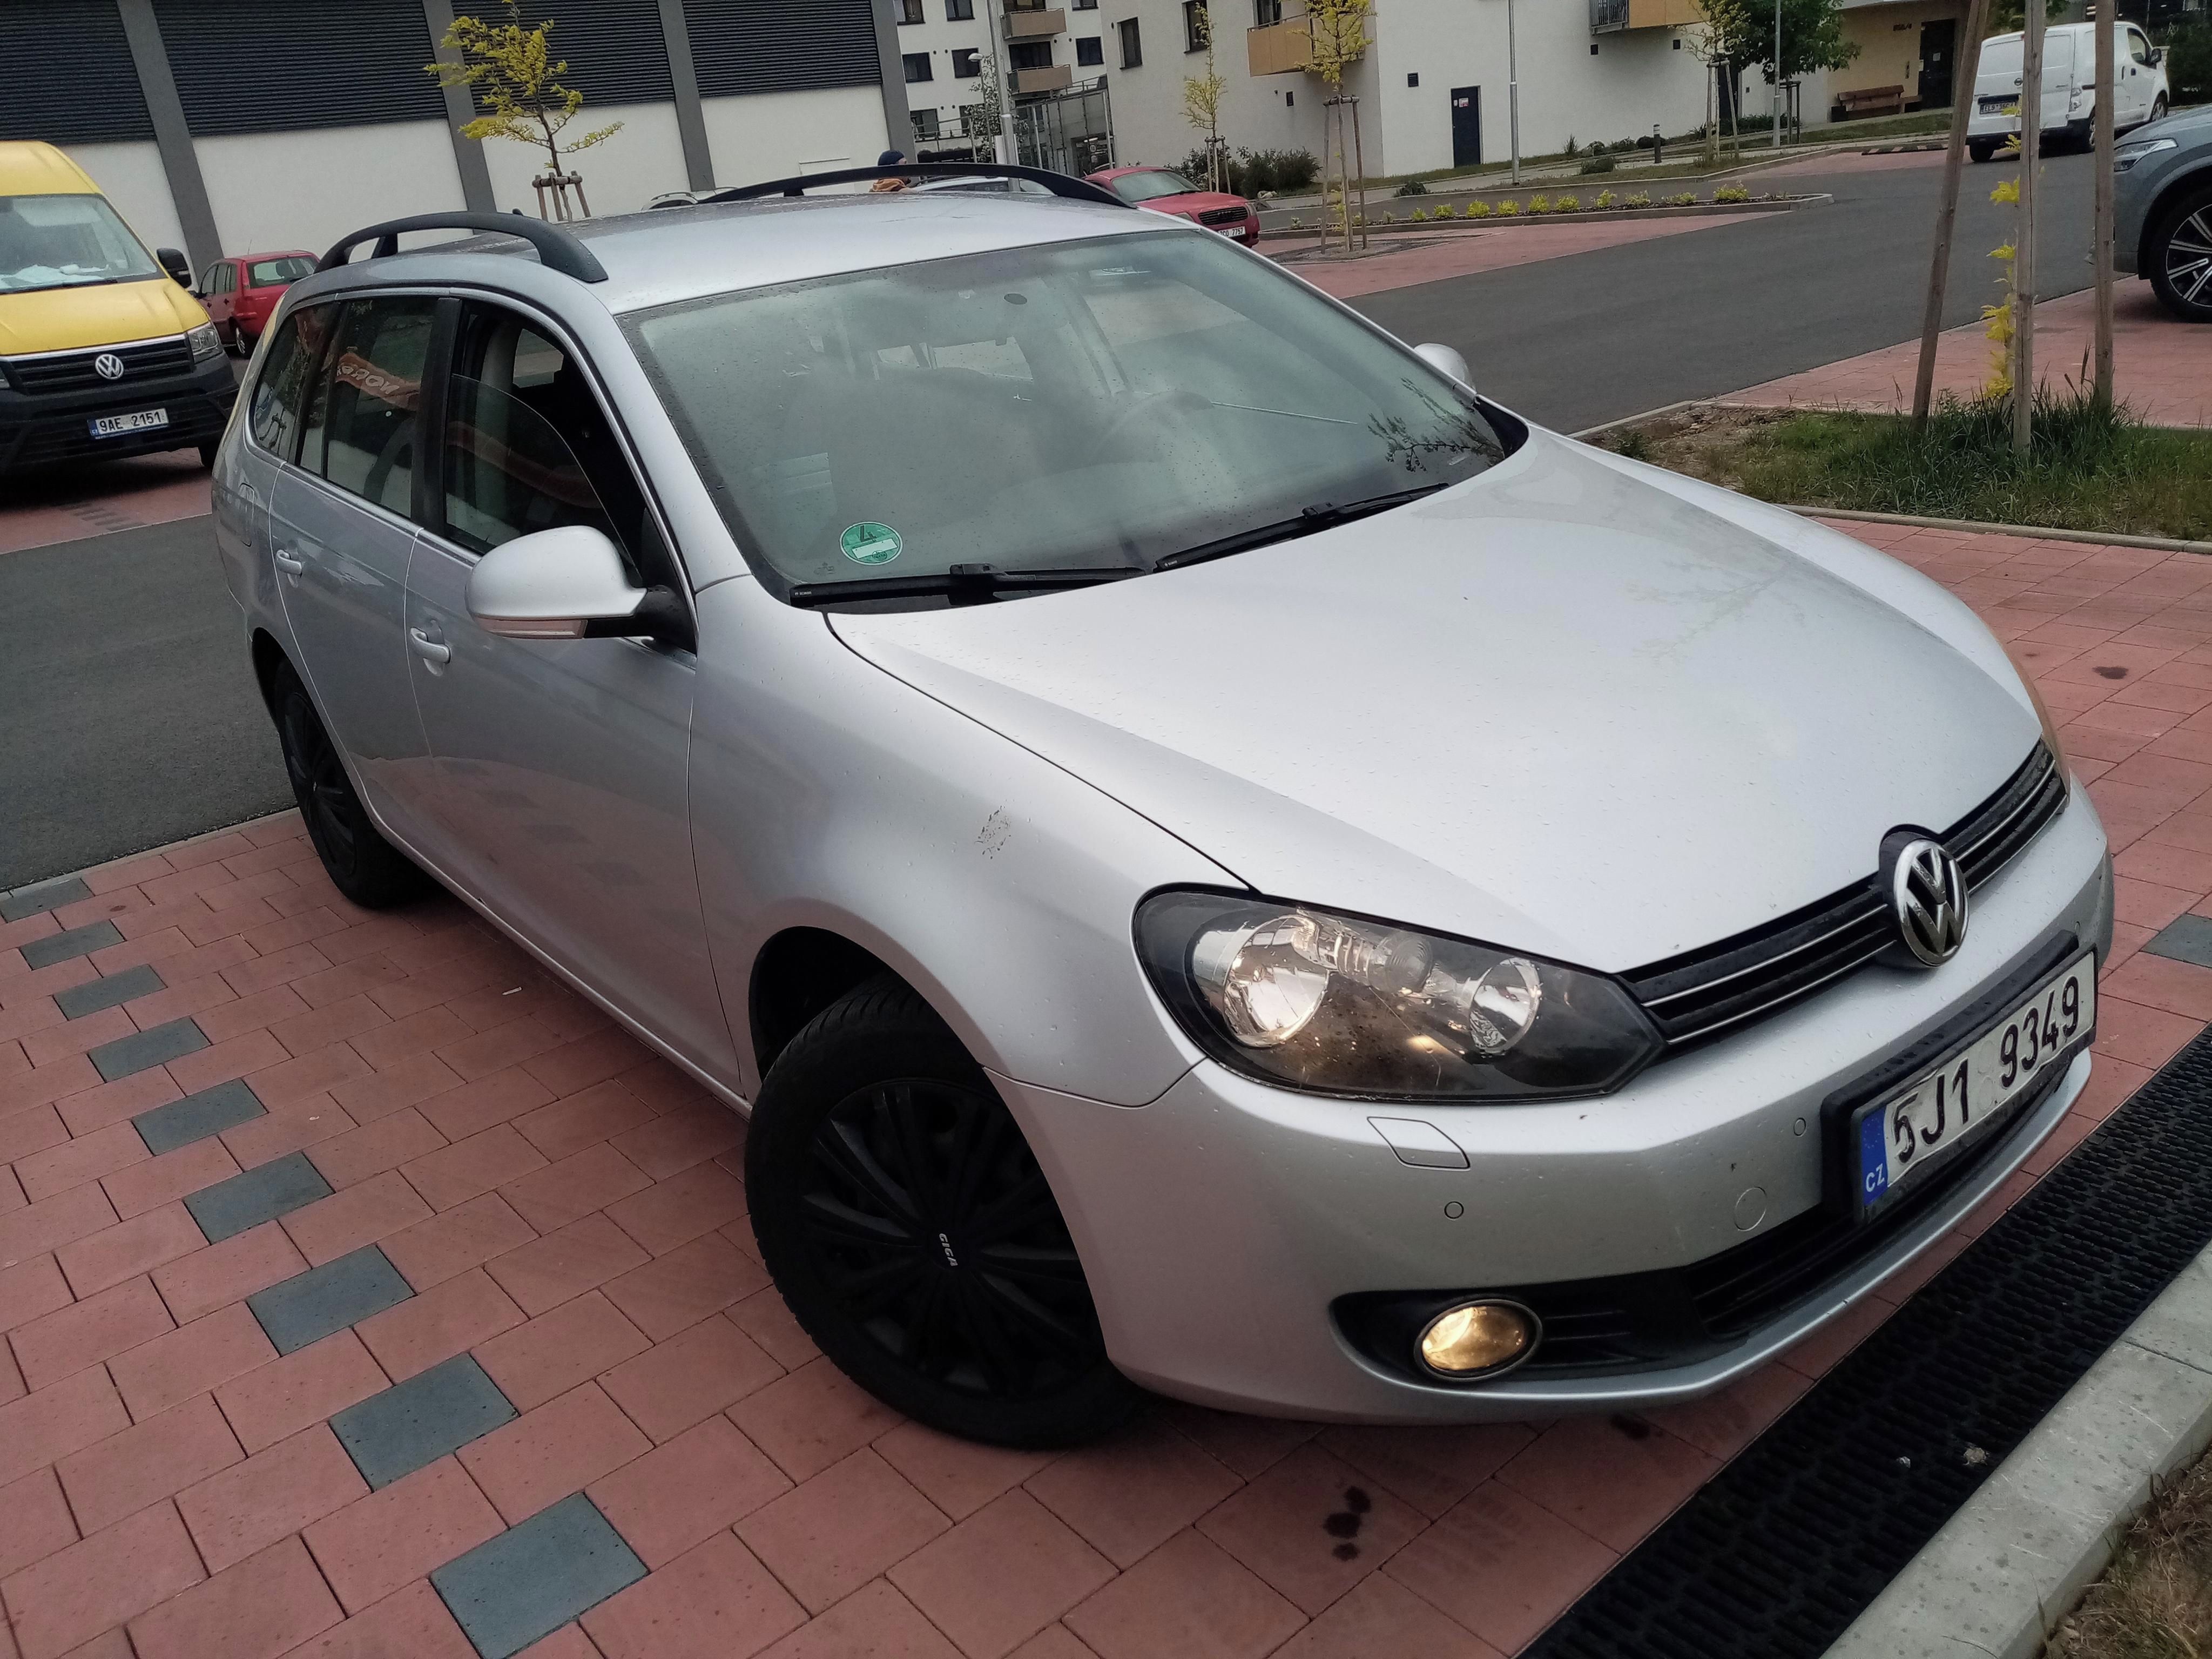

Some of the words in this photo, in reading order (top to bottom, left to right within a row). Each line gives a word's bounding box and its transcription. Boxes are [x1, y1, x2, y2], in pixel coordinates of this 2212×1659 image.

[99, 417, 124, 432] 9AE
[131, 411, 161, 427] 2151
[1894, 838, 1970, 966] VW
[1892, 1057, 1969, 1164] 5J1
[1999, 975, 2079, 1088] 9349
[1865, 1162, 1885, 1193] CZ
[939, 1233, 959, 1267] GIGA
